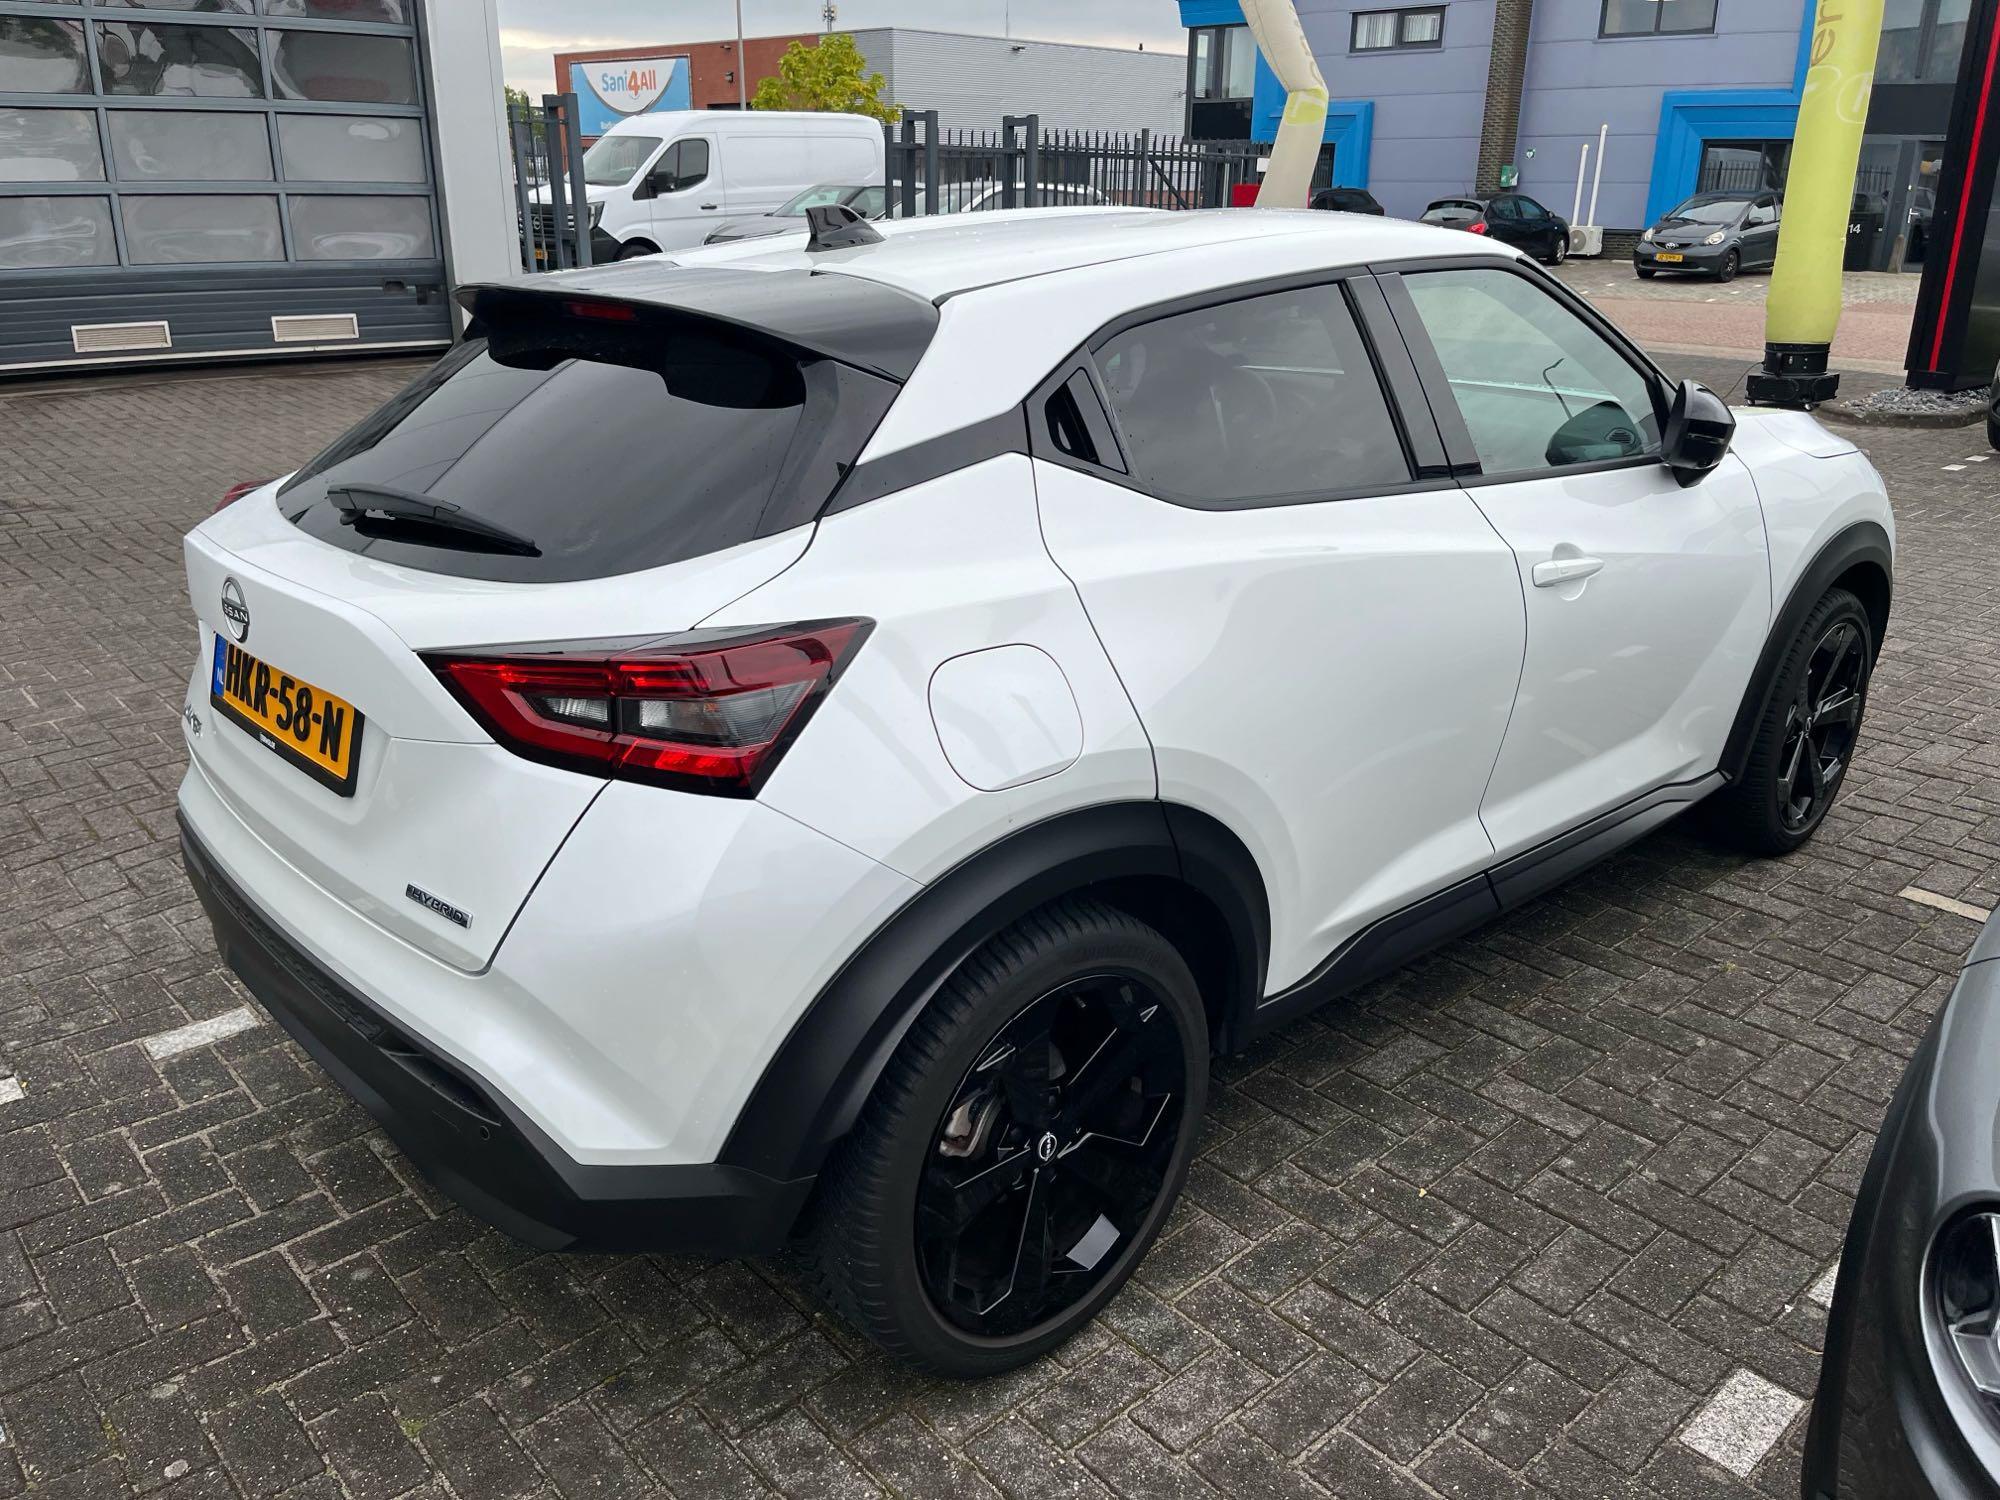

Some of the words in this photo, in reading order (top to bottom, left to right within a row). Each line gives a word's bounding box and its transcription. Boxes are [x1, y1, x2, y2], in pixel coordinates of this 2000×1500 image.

[601, 66, 657, 97] Sani4All
[1848, 223, 1861, 234] 14
[225, 643, 345, 763] HKR-58-N
[411, 887, 464, 924] HYBRID
